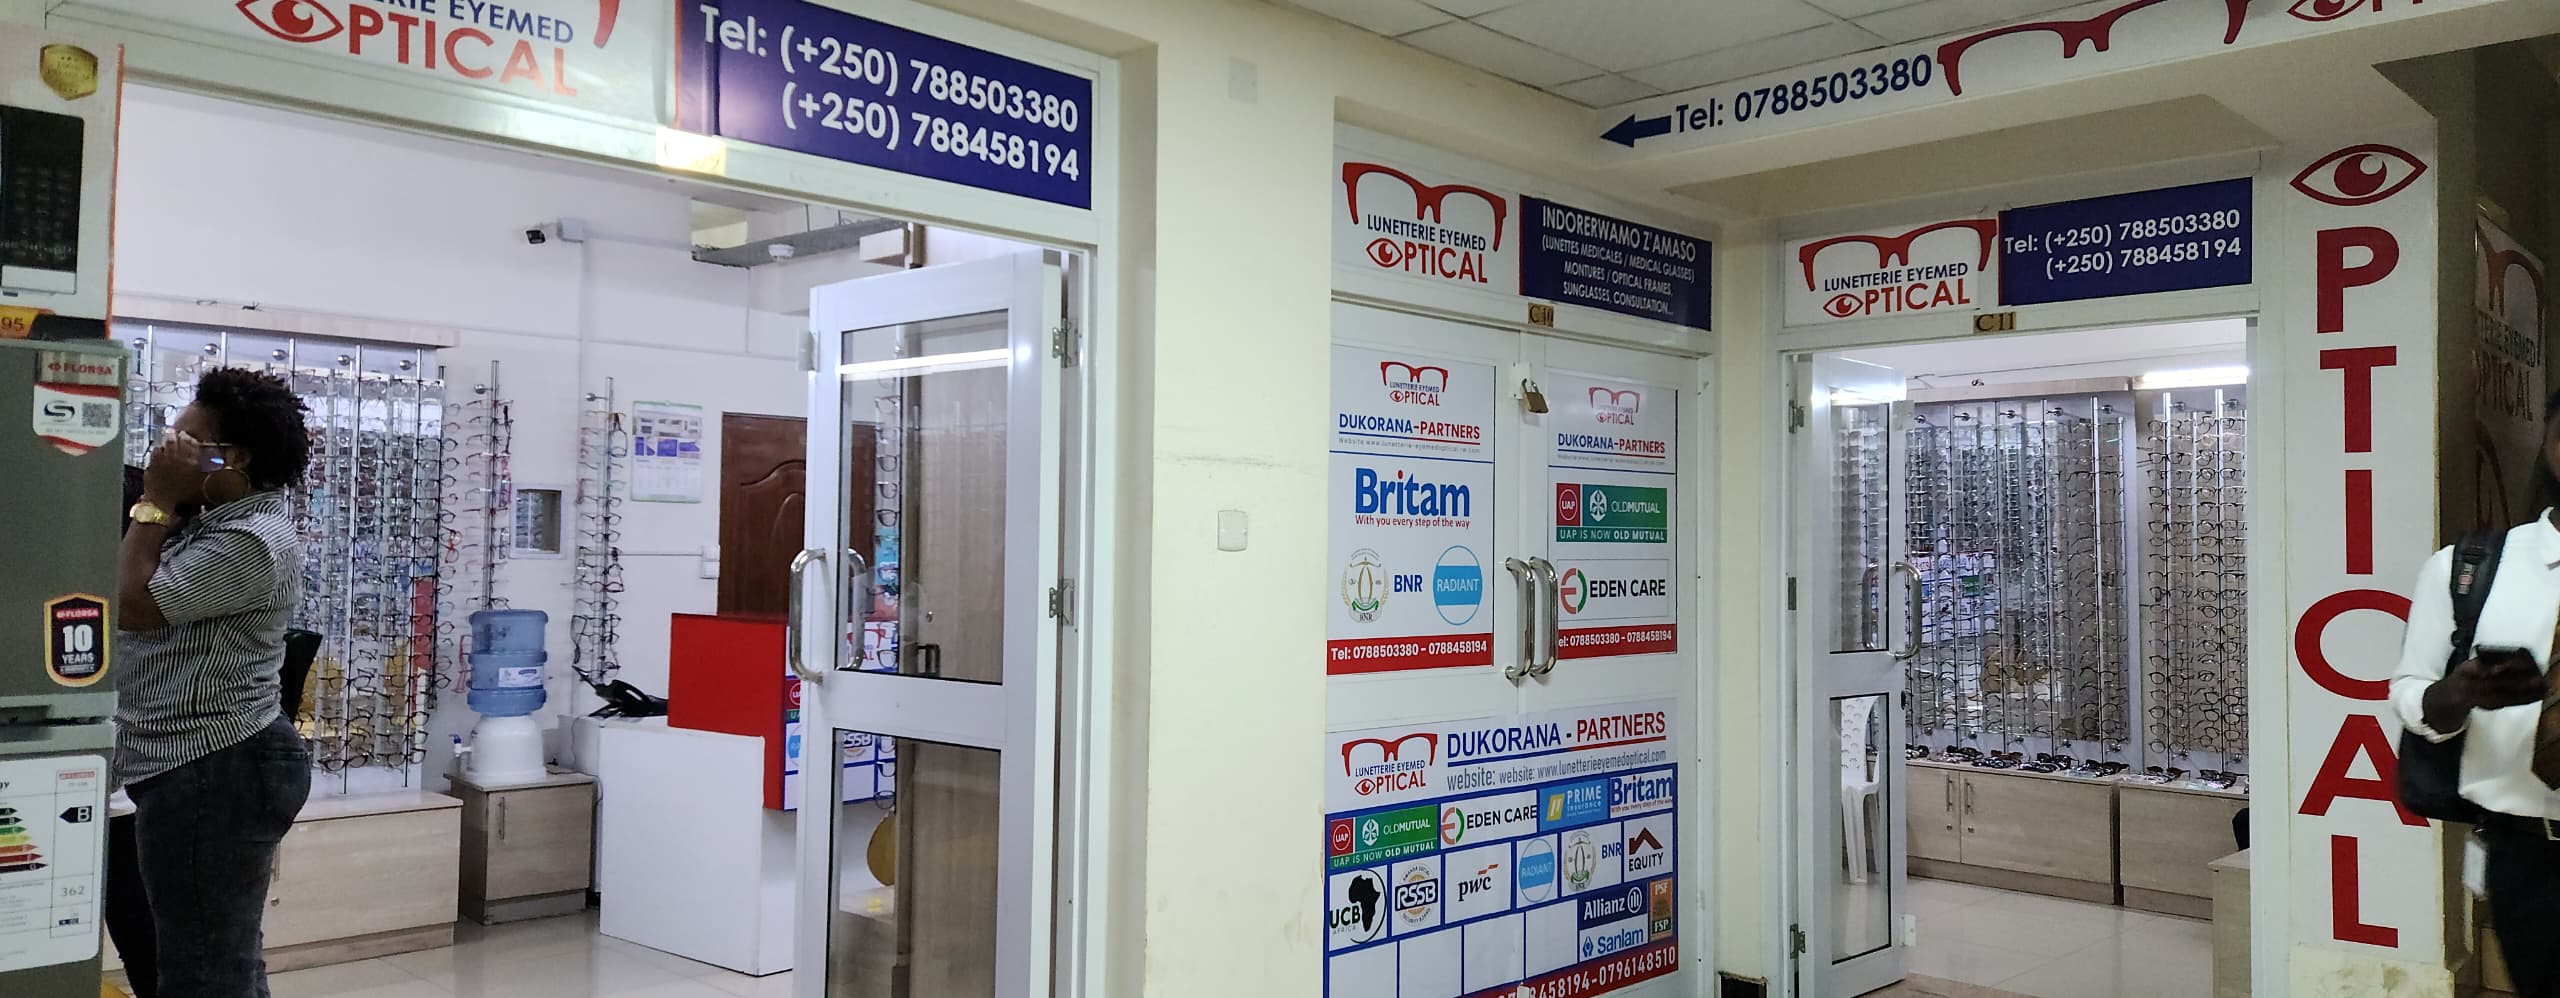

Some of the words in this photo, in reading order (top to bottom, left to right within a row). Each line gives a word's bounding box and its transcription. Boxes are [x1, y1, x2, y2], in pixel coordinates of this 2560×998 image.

[450, 0, 574, 44] EYEMED
[700, 4, 768, 58] Tel:
[780, 25, 899, 97] (+250)
[909, 60, 1079, 133] 788503380
[1676, 97, 1724, 132] Tel:
[1734, 54, 1932, 122] 0788503380
[782, 82, 900, 151] (+250)
[911, 112, 1080, 181] 788458194
[1367, 213, 1436, 242] LUNETTERIE
[1439, 228, 1486, 251] EYEMED
[1542, 205, 1641, 248] INDORERWAMO
[1643, 231, 1697, 263] Z'AMASO
[2004, 233, 2040, 255] Tel:
[2045, 223, 2113, 252] (+250)
[2119, 209, 2241, 241] 788503380
[1541, 234, 1579, 255] (LUNETTES
[1580, 243, 1623, 265] MEDICALES
[1629, 254, 1662, 274] MEDICAL
[1663, 263, 1695, 284] GLASSES)
[2045, 250, 2113, 279] (+250)
[2121, 237, 2242, 267] 788458194
[1564, 261, 1605, 281] MONTURES
[1611, 270, 1643, 290] OPTICAL
[1824, 268, 1903, 292] LUNETTERIE
[1907, 261, 1968, 281] EYEMED
[1339, 413, 1480, 440] DUKORANA-PARTNERS
[1558, 433, 1665, 454] DUKORANA-PARTNERS
[1355, 468, 1470, 517] Britam
[1561, 500, 1576, 510] UAP
[1355, 516, 1374, 525] With
[1377, 518, 1391, 527] you
[1392, 518, 1413, 528] every
[1415, 517, 1431, 528] step
[1433, 517, 1441, 527] of
[1441, 518, 1454, 527] the
[1455, 520, 1470, 529] way
[1560, 531, 1577, 540] UAP
[1580, 532, 1588, 540] IS
[1591, 532, 1611, 540] NOW
[1613, 532, 1630, 540] OLD
[1632, 533, 1665, 541] MUTUAL
[1394, 575, 1423, 592] BNR
[1437, 579, 1480, 592] RADIANT
[1590, 580, 1627, 597] EDEN
[1630, 579, 1666, 596] CARE
[63, 624, 93, 652] 10
[1558, 634, 1569, 647] el:
[1570, 632, 1620, 647] 0788503380
[1627, 630, 1672, 643] 0788458194
[62, 652, 94, 665] YEARS
[1331, 647, 1351, 661] Tel:
[1353, 643, 1419, 659] 0788503380
[1428, 640, 1487, 655] 0788458194
[1448, 723, 1561, 759] DUKORANA
[1577, 711, 1665, 742] PARTNERS
[1355, 764, 1395, 777] LUNETTERIE
[1397, 760, 1425, 772] EYEMED
[1447, 767, 1496, 791] website:
[1500, 771, 1535, 785] website:
[1567, 785, 1602, 805] PRIME
[1610, 776, 1673, 806] Britam
[78, 807, 90, 822] B
[1467, 810, 1500, 829] EDEN
[1504, 805, 1537, 823] CARE
[1335, 833, 1349, 843] UAP
[1333, 857, 1350, 867] UAP
[1352, 855, 1360, 864] IS
[1363, 852, 1382, 862] NOW
[1385, 848, 1401, 857] OLD
[1403, 841, 1434, 854] MUTUAL
[1602, 842, 1622, 860] BNR
[1629, 852, 1664, 872] EQUITY
[1521, 862, 1553, 878] RADIANT
[1397, 881, 1436, 910] RSSB
[1458, 876, 1492, 902] pwc
[1329, 906, 1360, 928] UCB
[1584, 896, 1625, 921] Allianz
[1654, 919, 1669, 932] FSP
[1597, 928, 1644, 953] Sanlam
